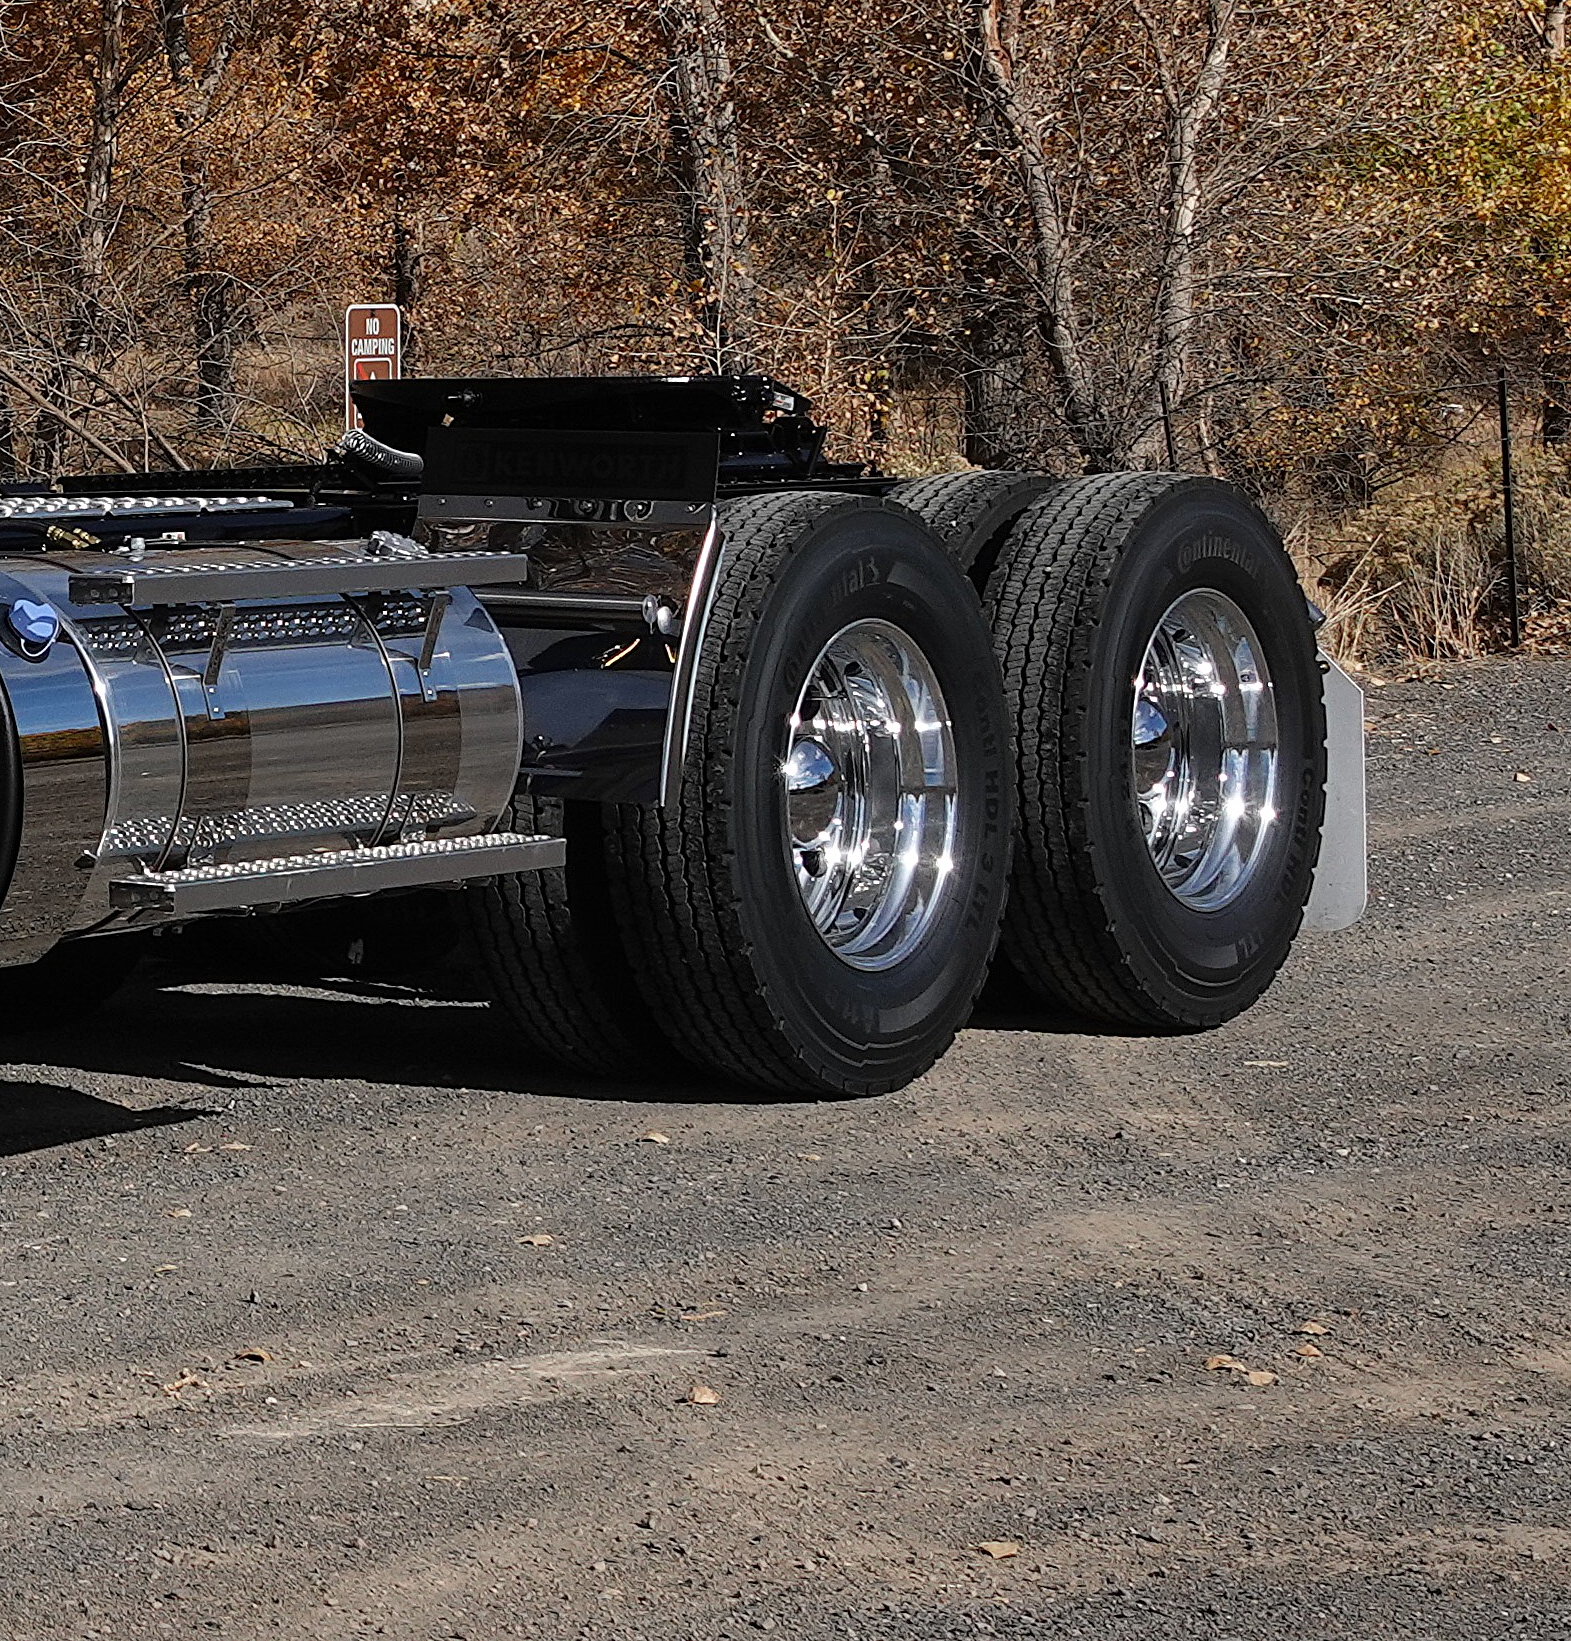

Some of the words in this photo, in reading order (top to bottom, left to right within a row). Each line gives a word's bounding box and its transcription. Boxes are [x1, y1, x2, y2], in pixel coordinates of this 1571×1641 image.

[366, 318, 380, 336] NO
[351, 338, 395, 356] CAMPING
[495, 448, 682, 481] KENWORTH
[1177, 533, 1259, 578] Continental
